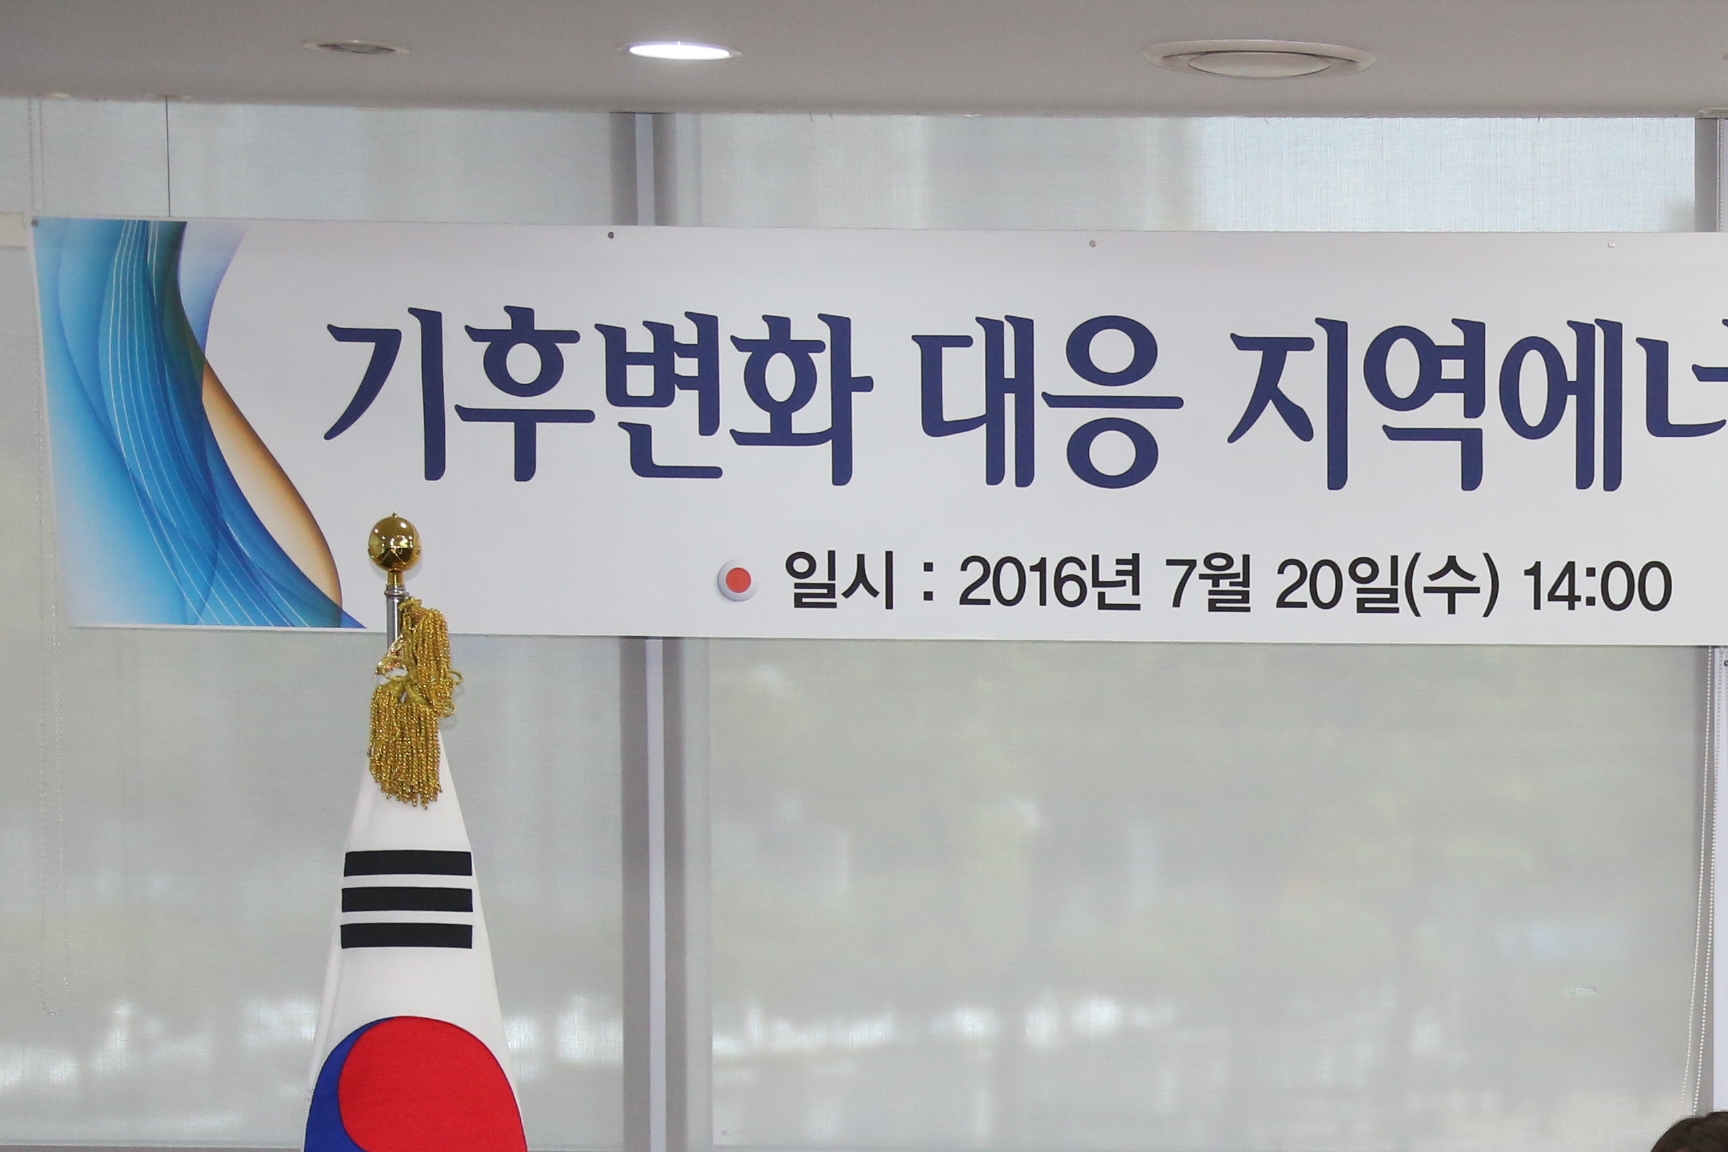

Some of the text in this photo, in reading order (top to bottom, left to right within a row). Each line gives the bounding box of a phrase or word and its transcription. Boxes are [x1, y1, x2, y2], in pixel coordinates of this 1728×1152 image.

[323, 305, 873, 486] 기후변화
[912, 315, 1184, 489] 대응
[786, 550, 893, 609] 일시
[960, 553, 1140, 610] 2016년
[1166, 553, 1250, 612] 7월
[1276, 553, 1499, 617] 20일(수)
[1524, 561, 1672, 611] 14:00
